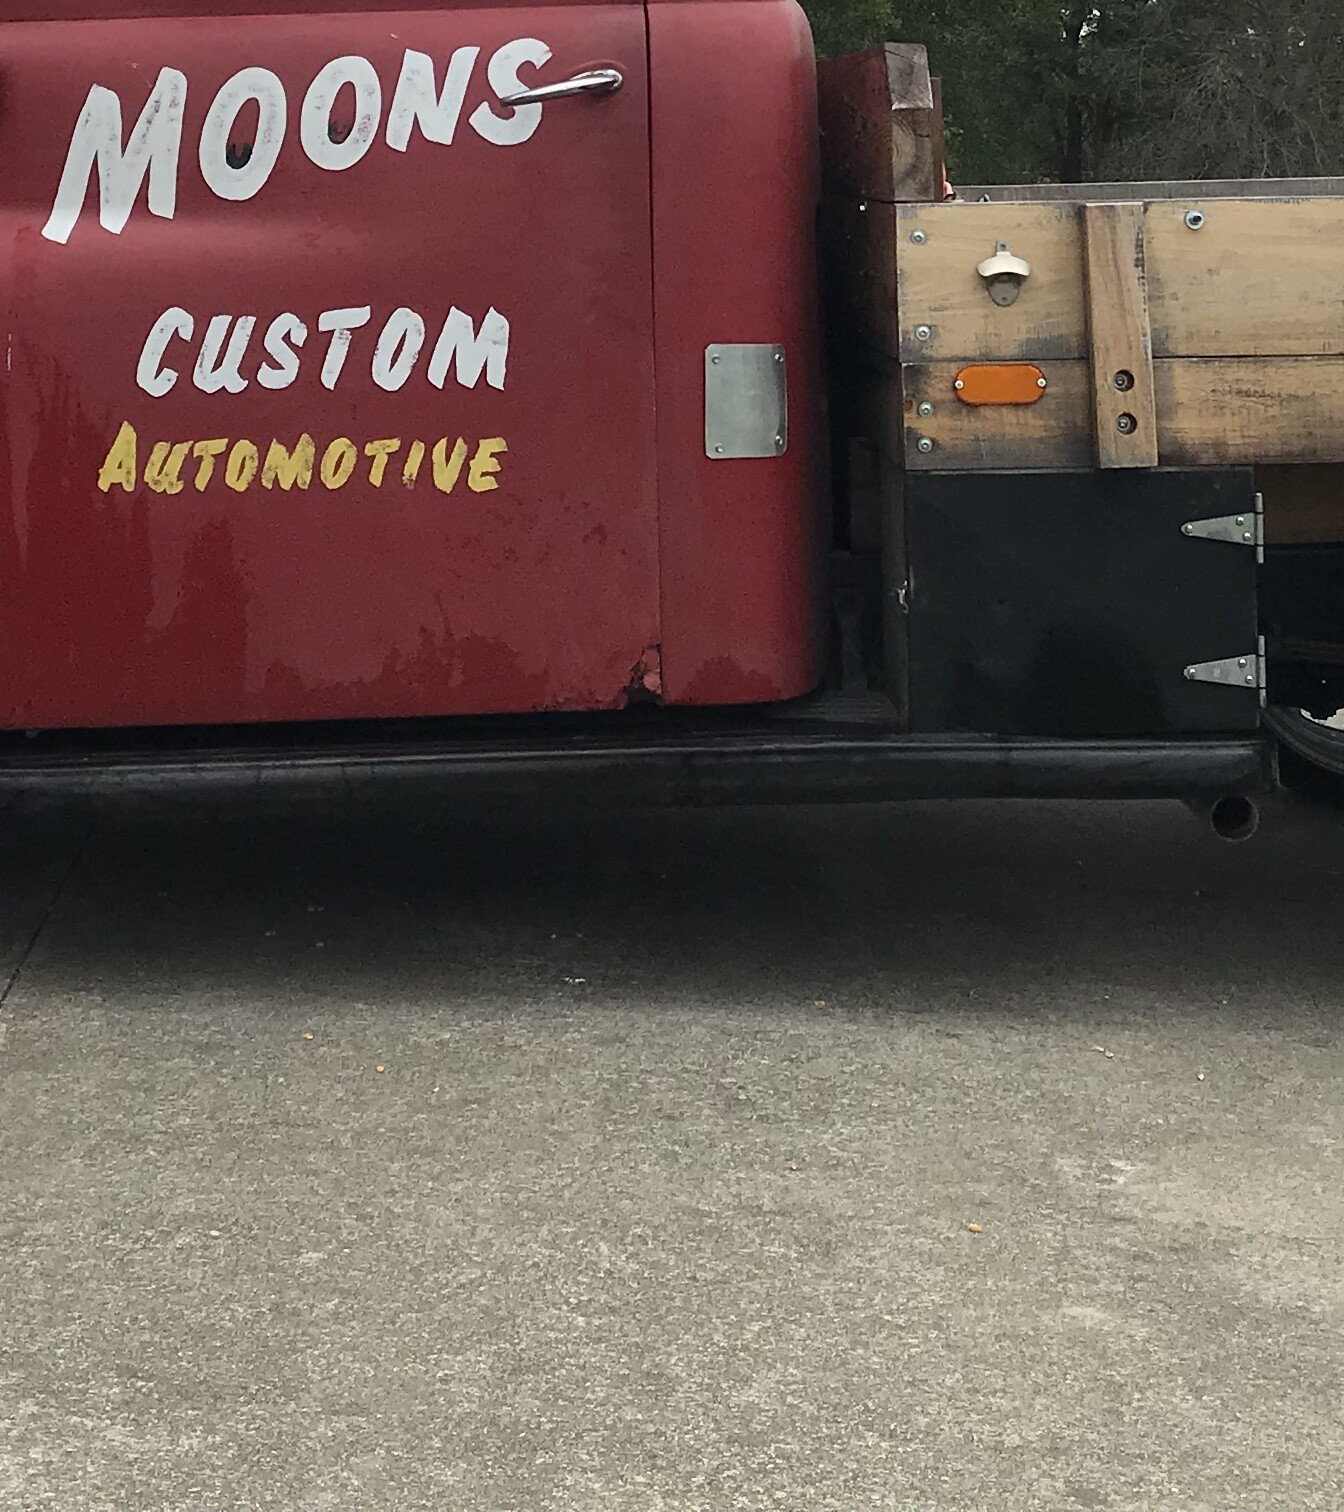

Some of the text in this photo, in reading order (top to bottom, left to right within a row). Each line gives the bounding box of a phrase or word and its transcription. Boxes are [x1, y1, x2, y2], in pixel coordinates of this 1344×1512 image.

[41, 38, 552, 244] MOONS
[136, 305, 510, 397] CUSTOM
[98, 420, 508, 494] AUTOMOTIVE
